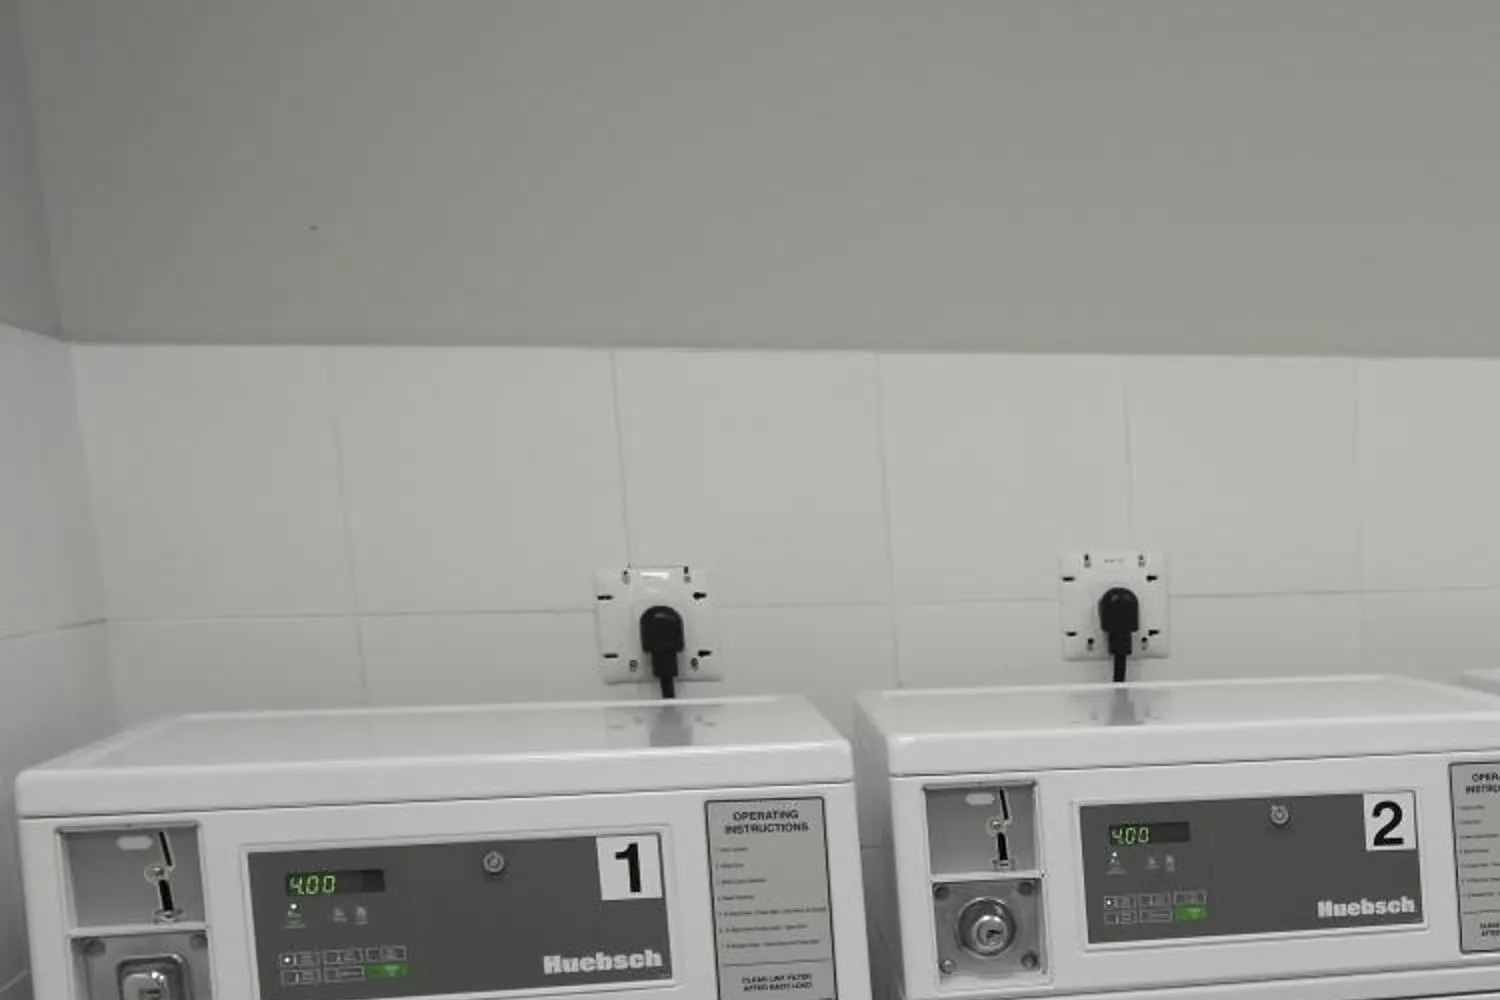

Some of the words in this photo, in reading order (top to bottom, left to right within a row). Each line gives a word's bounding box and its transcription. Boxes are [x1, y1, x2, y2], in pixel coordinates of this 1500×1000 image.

[732, 809, 800, 822] OPERATING
[1372, 800, 1404, 847] 2
[725, 821, 810, 836] INSTRUCTIONS
[614, 842, 642, 893] 1
[1316, 895, 1416, 919] Huebsch
[542, 948, 663, 975] Huebsch
